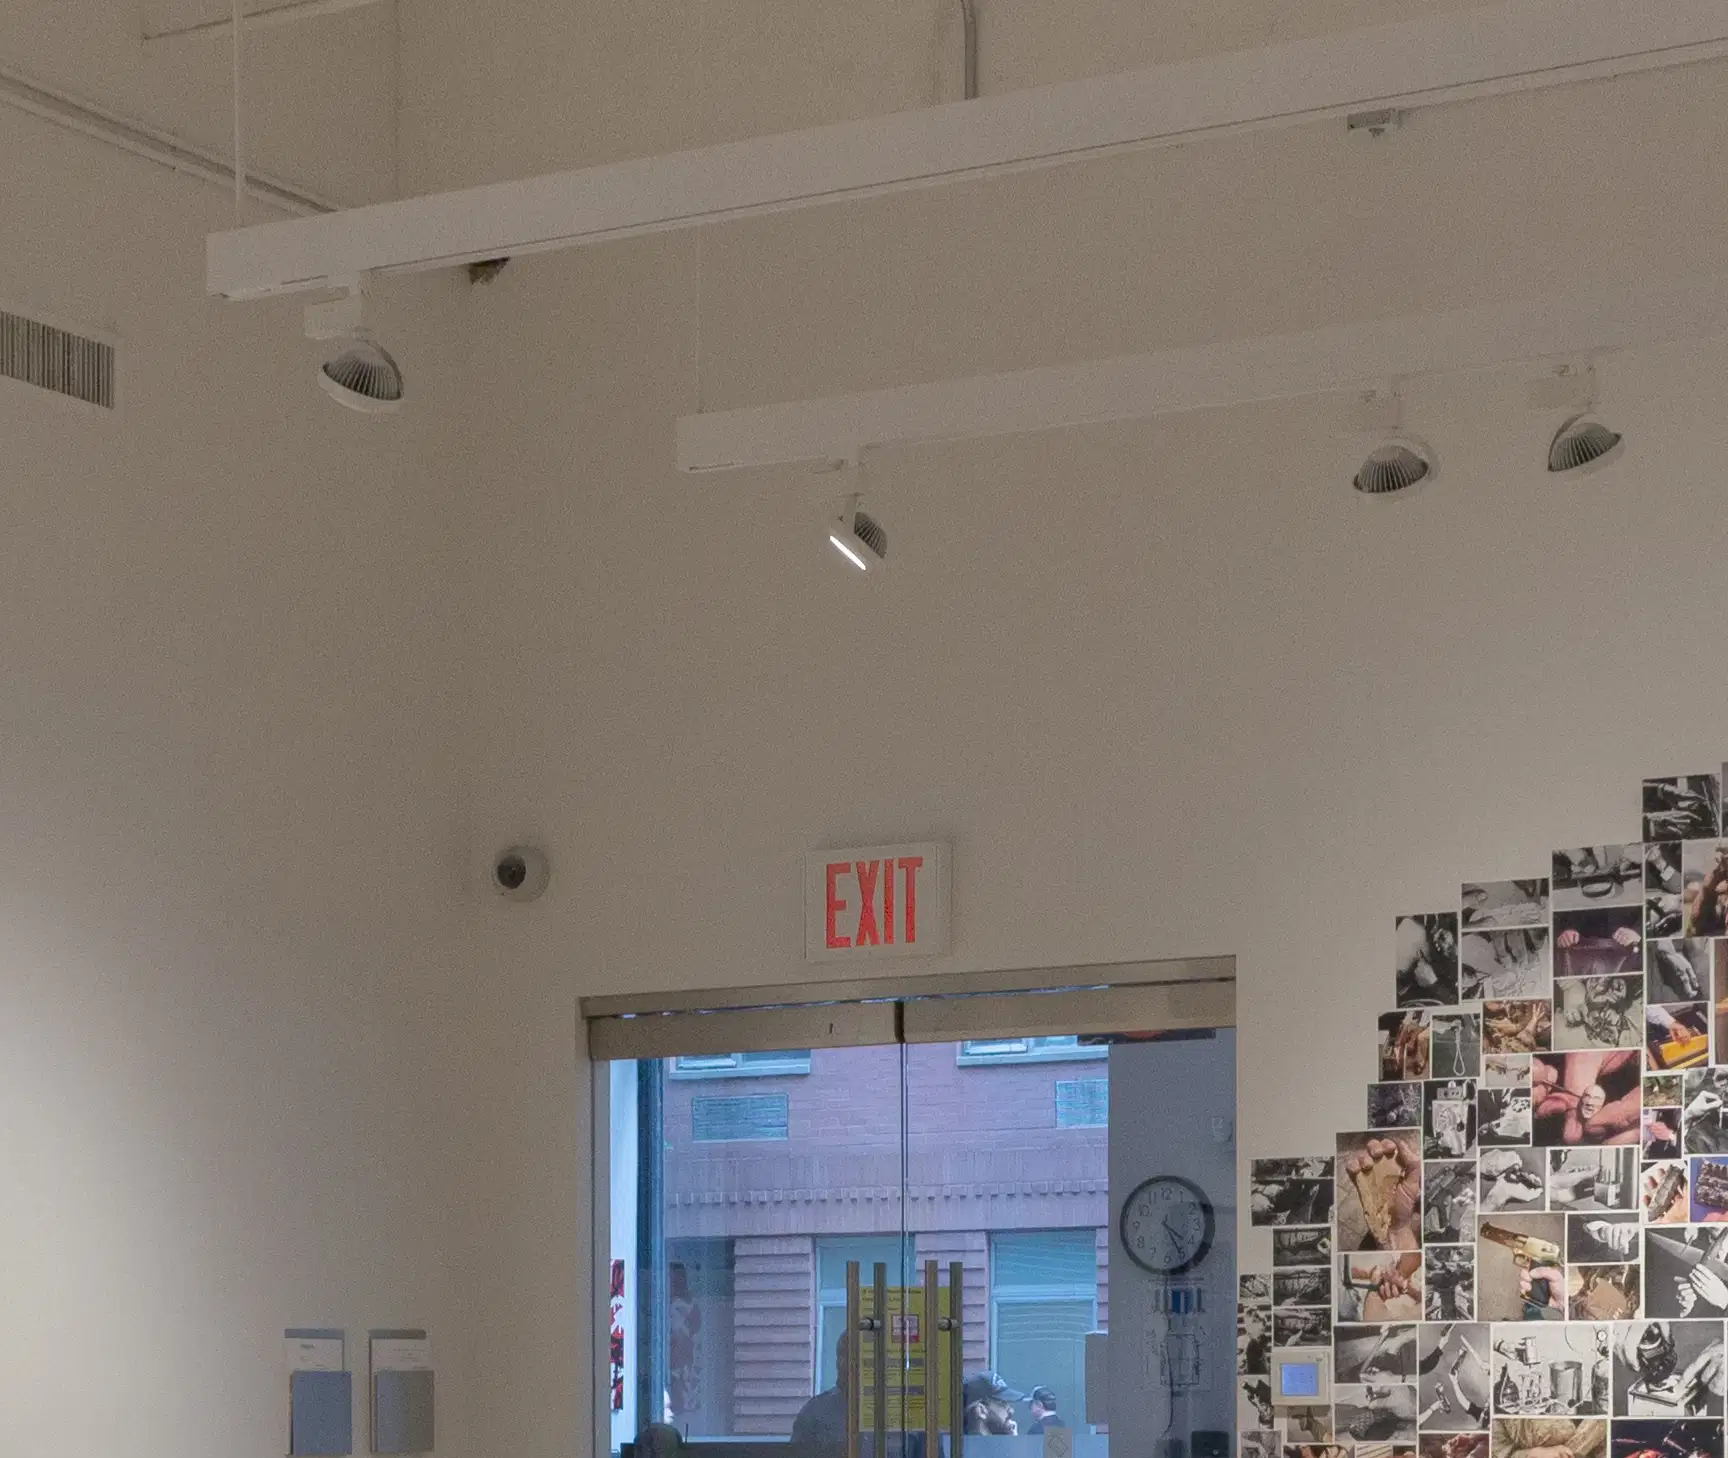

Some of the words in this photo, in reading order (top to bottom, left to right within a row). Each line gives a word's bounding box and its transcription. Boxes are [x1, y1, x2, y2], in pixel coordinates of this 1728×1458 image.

[826, 857, 923, 949] EXIT
[1160, 1187, 1173, 1200] 12
[1188, 1202, 1197, 1215] 2
[1191, 1218, 1200, 1231] 3
